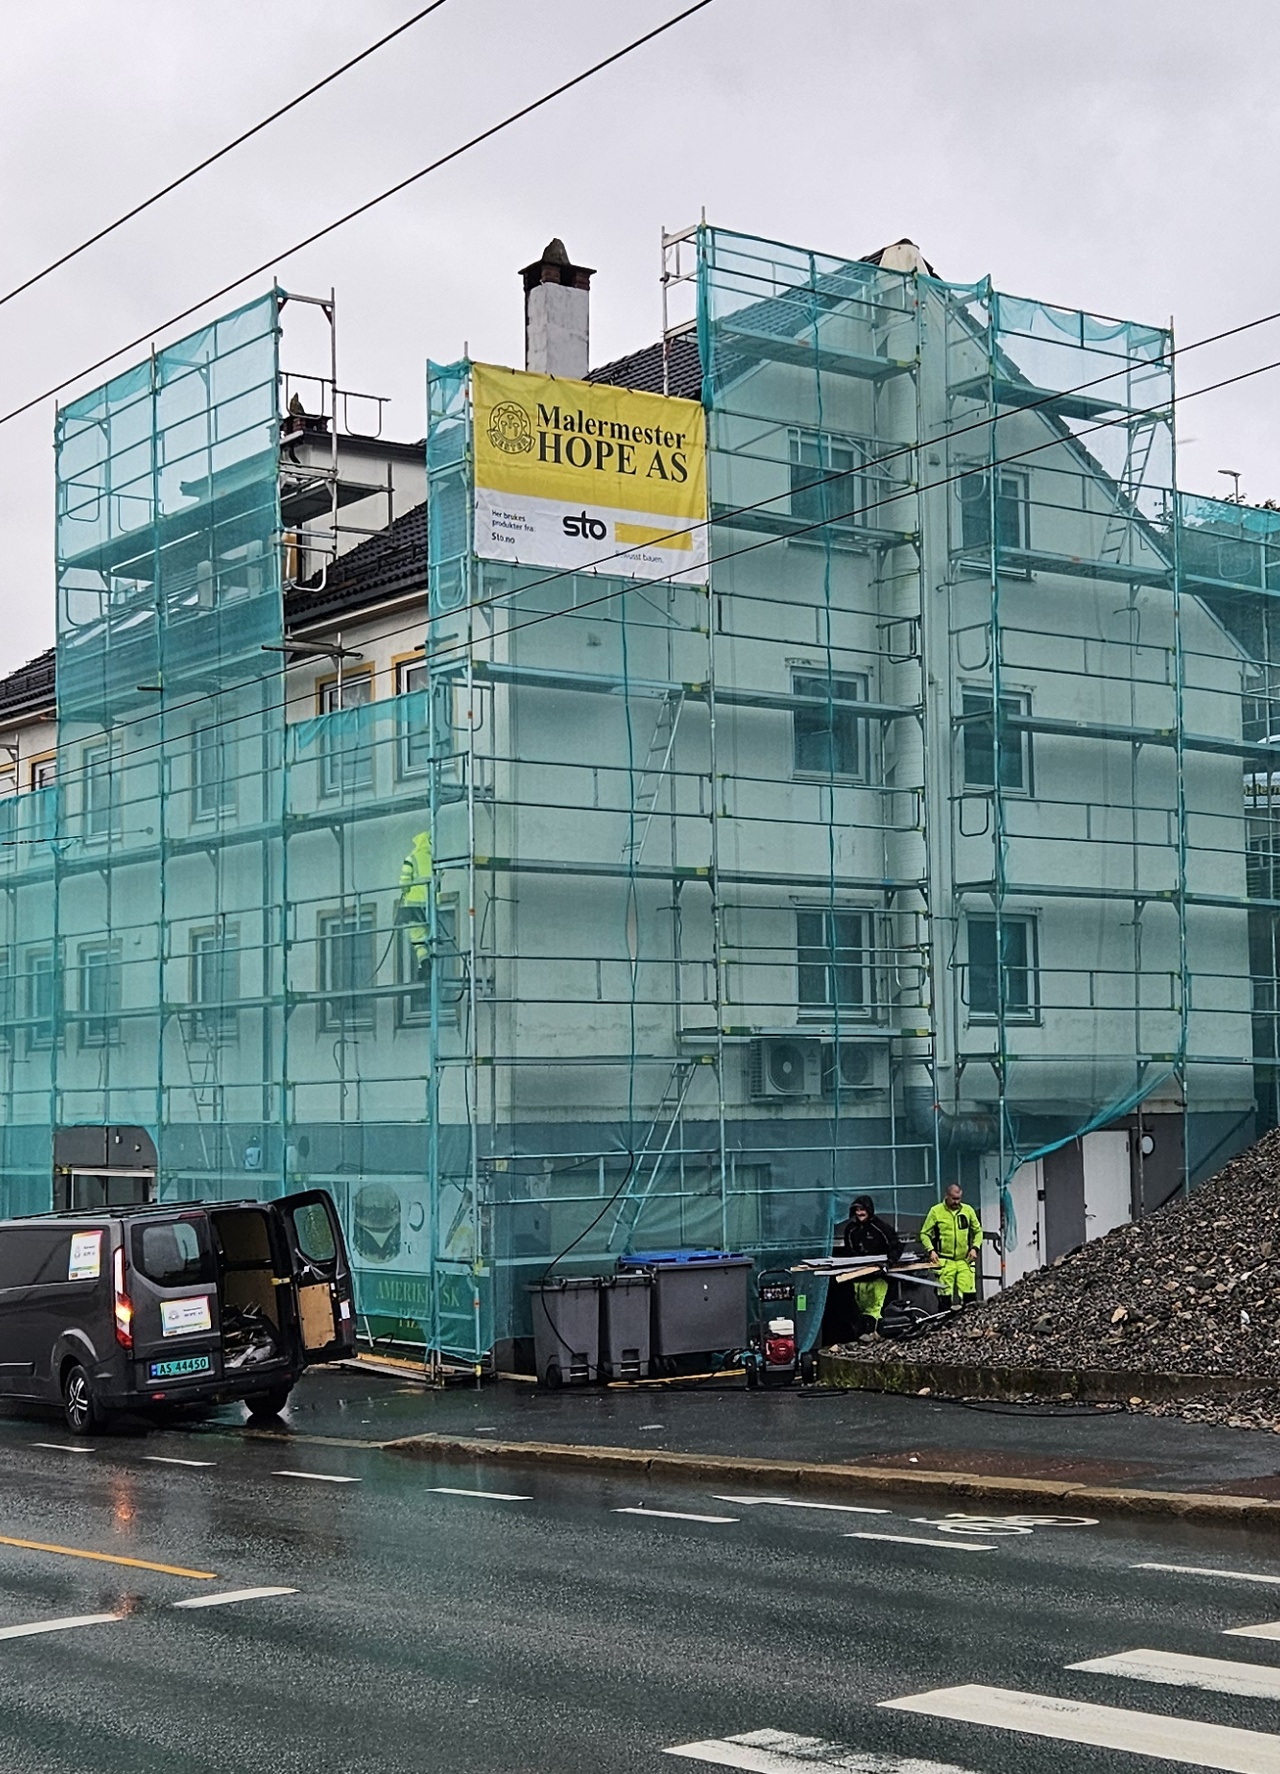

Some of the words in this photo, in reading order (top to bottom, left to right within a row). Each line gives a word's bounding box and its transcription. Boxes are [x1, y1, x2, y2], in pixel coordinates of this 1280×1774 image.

[536, 402, 686, 449] Malermester
[536, 429, 638, 476] HOPE
[645, 449, 688, 484] AS
[562, 510, 608, 541] sto
[159, 1363, 172, 1375] AS
[175, 1358, 207, 1371] 44450
